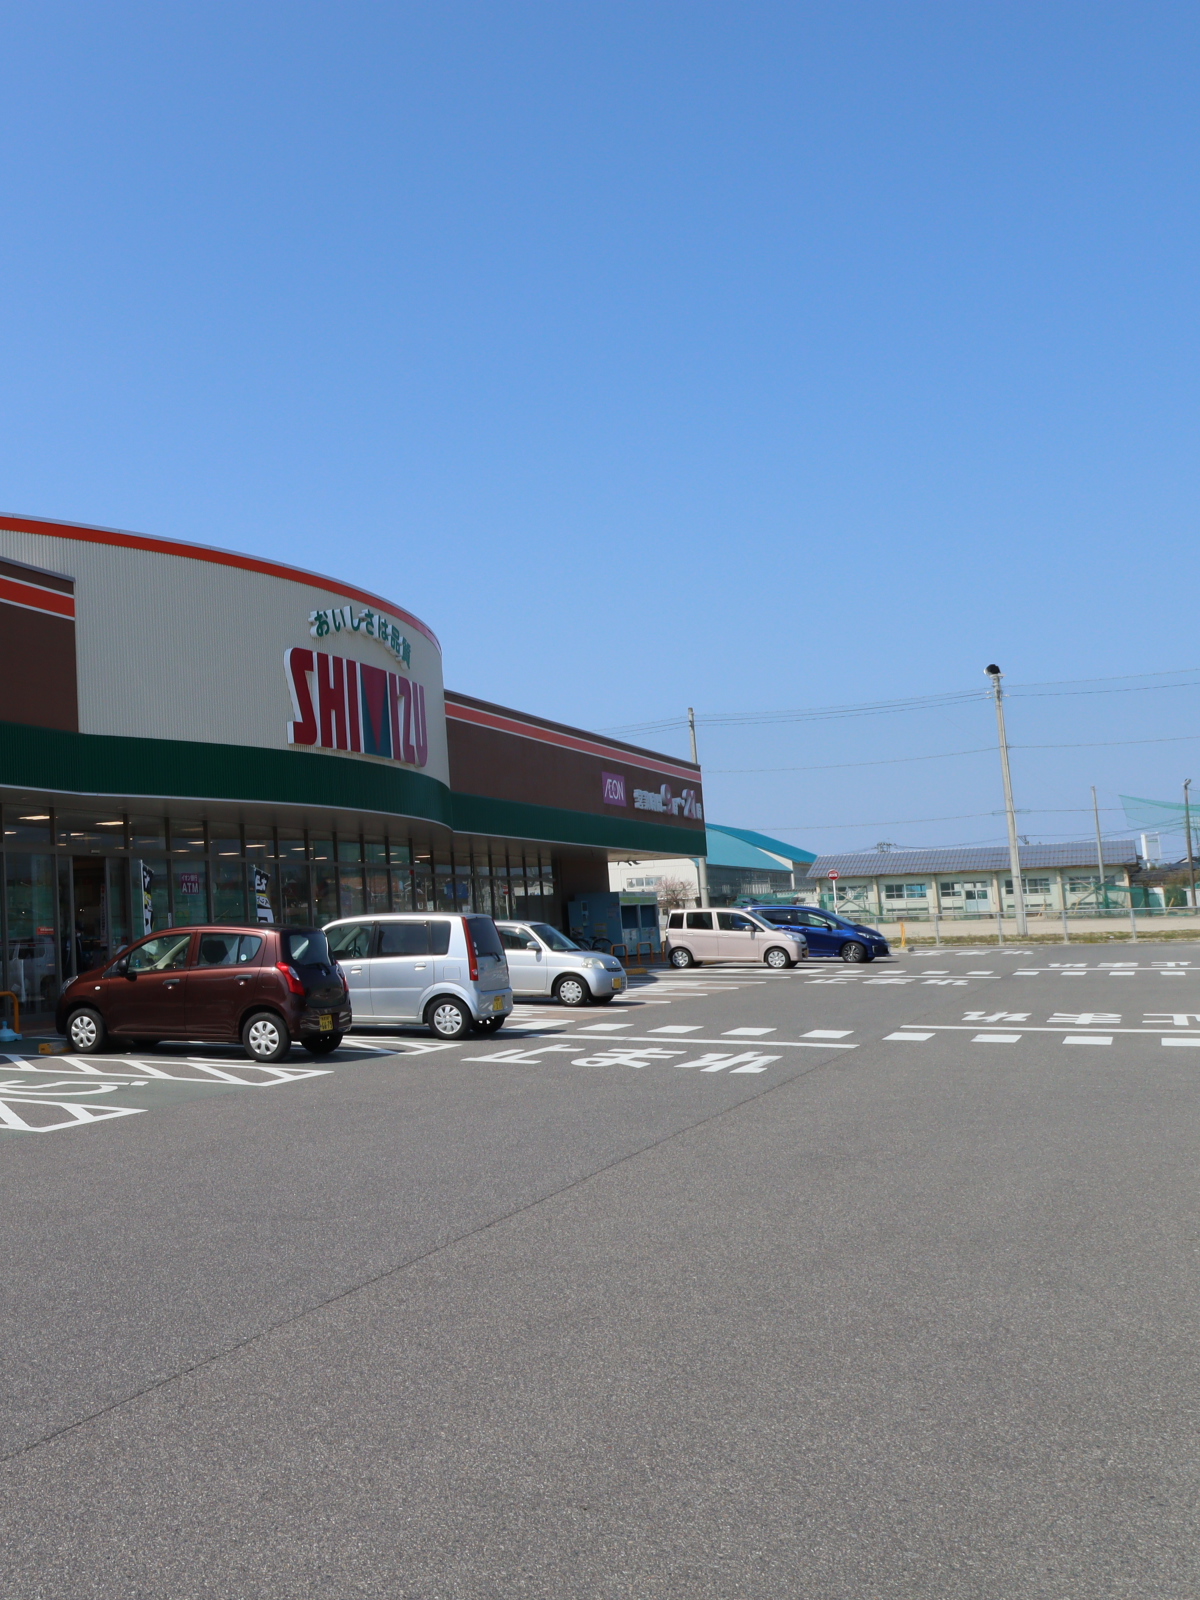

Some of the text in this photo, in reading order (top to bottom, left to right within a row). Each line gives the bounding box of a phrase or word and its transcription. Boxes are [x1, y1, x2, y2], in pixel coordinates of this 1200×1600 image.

[181, 883, 199, 893] ATM
[460, 1044, 784, 1074] 止まれ
